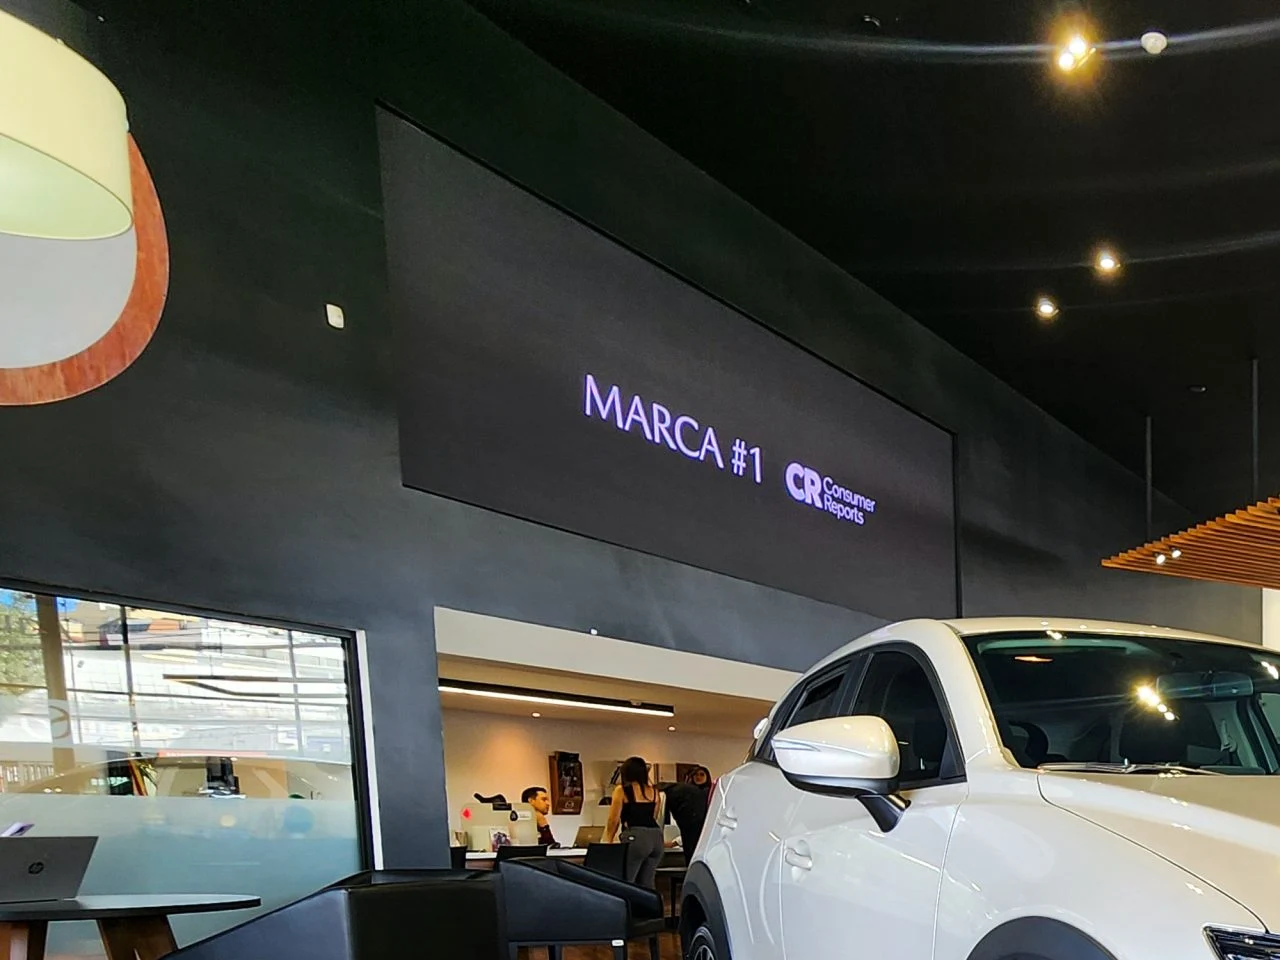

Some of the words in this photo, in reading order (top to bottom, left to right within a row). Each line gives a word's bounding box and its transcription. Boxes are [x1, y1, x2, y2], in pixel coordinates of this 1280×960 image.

[584, 374, 724, 469] MARCA
[731, 438, 762, 483] #1
[785, 462, 823, 508] CR
[823, 476, 876, 513] Consumer
[823, 494, 865, 525] Reports
